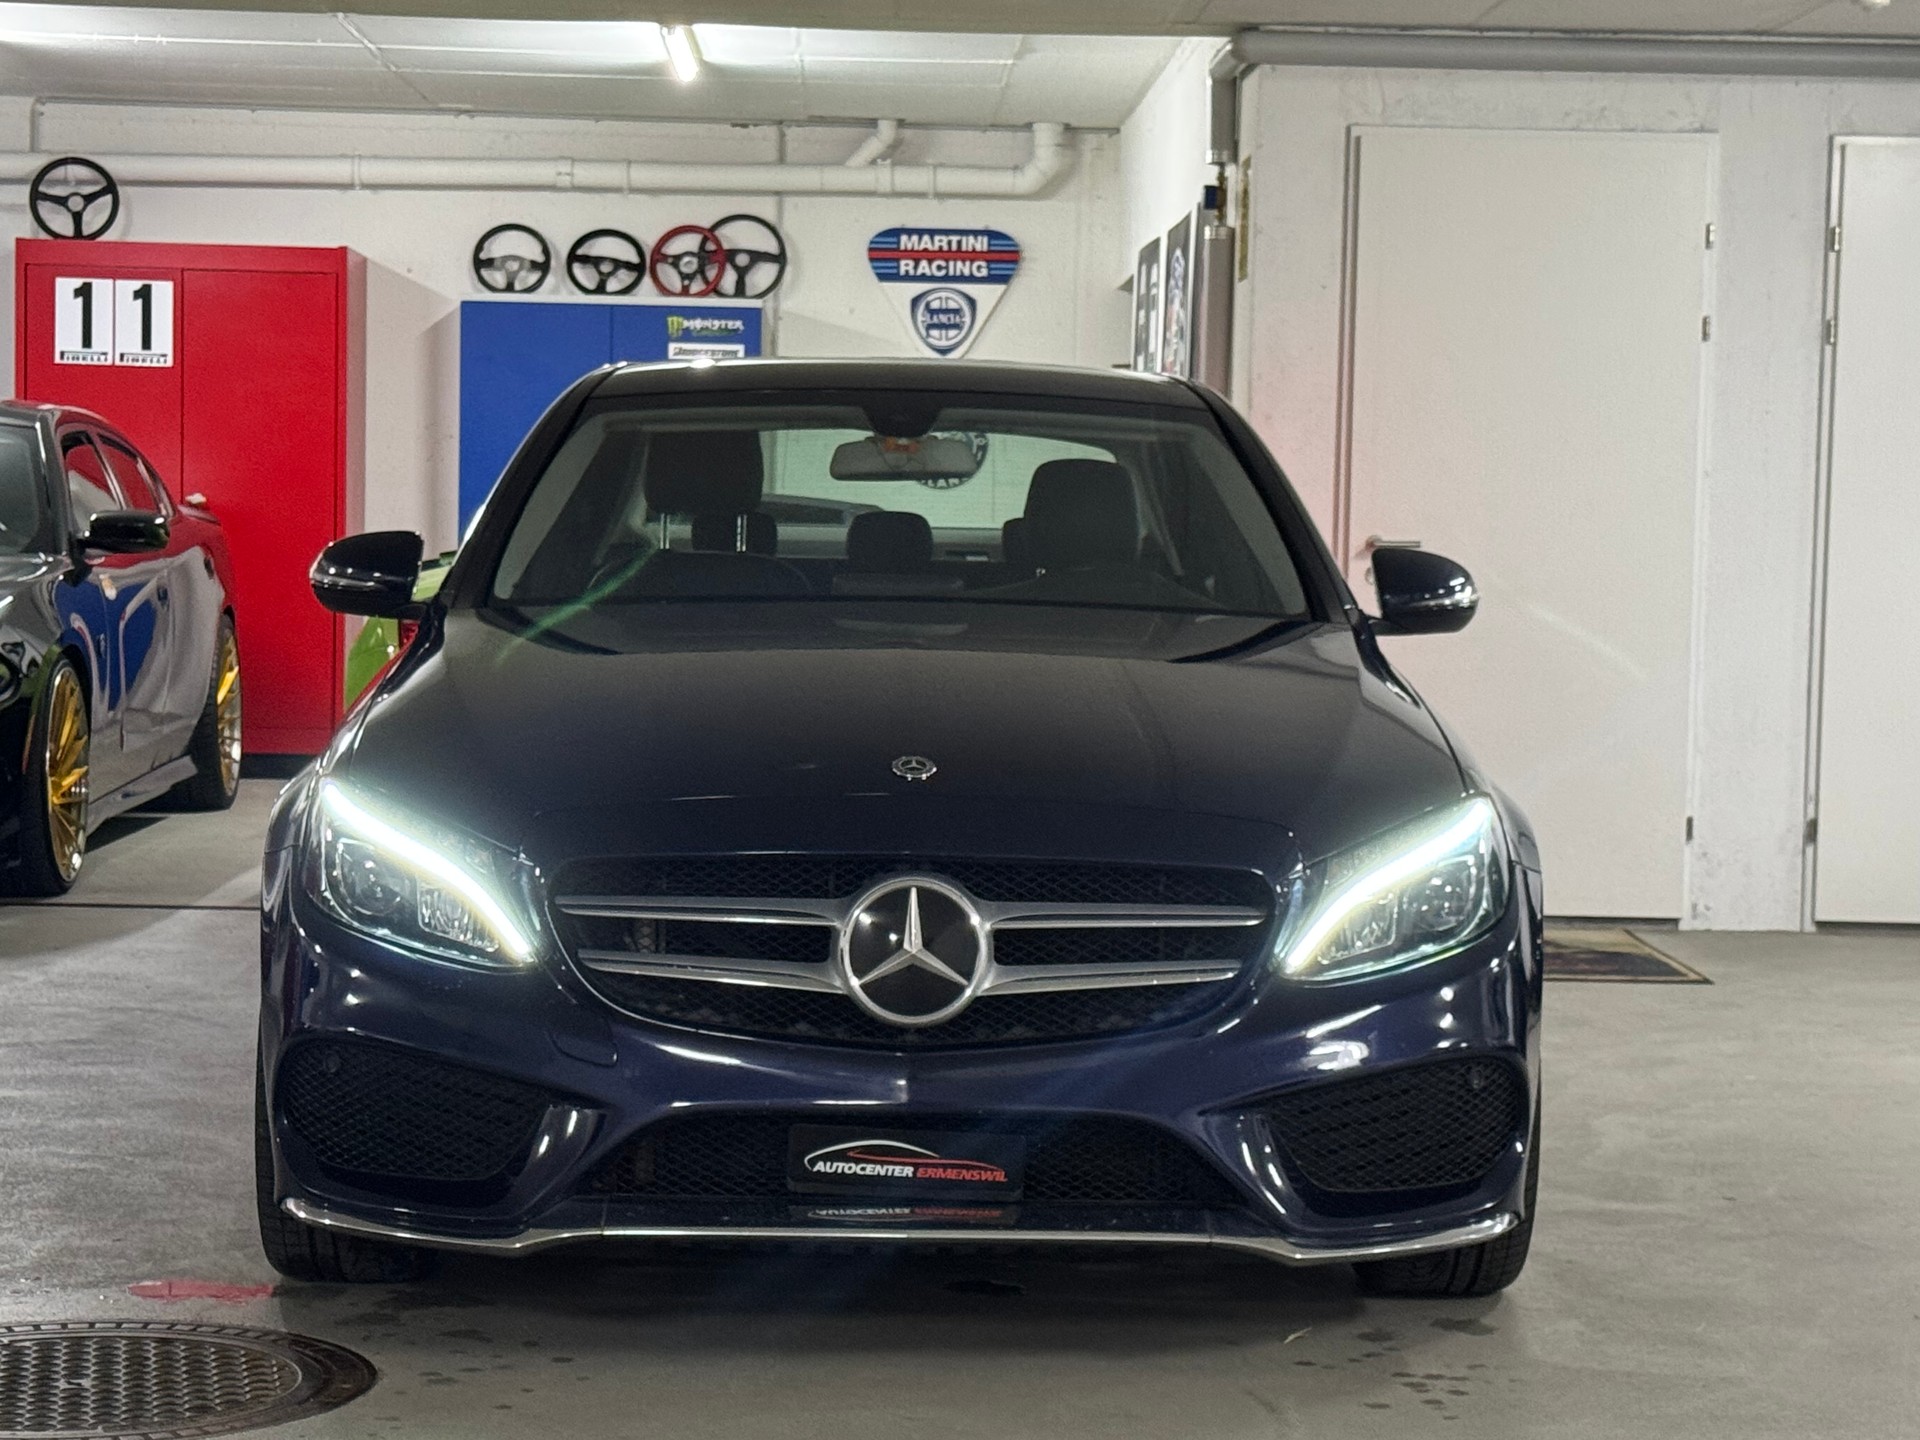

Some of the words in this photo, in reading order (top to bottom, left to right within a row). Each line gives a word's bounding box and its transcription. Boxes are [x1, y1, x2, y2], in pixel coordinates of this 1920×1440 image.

[900, 234, 988, 251] MARTINI
[900, 260, 988, 277] RACING
[813, 1161, 914, 1178] AUTOCENTER
[916, 1166, 1008, 1182] ERMENSWIL
